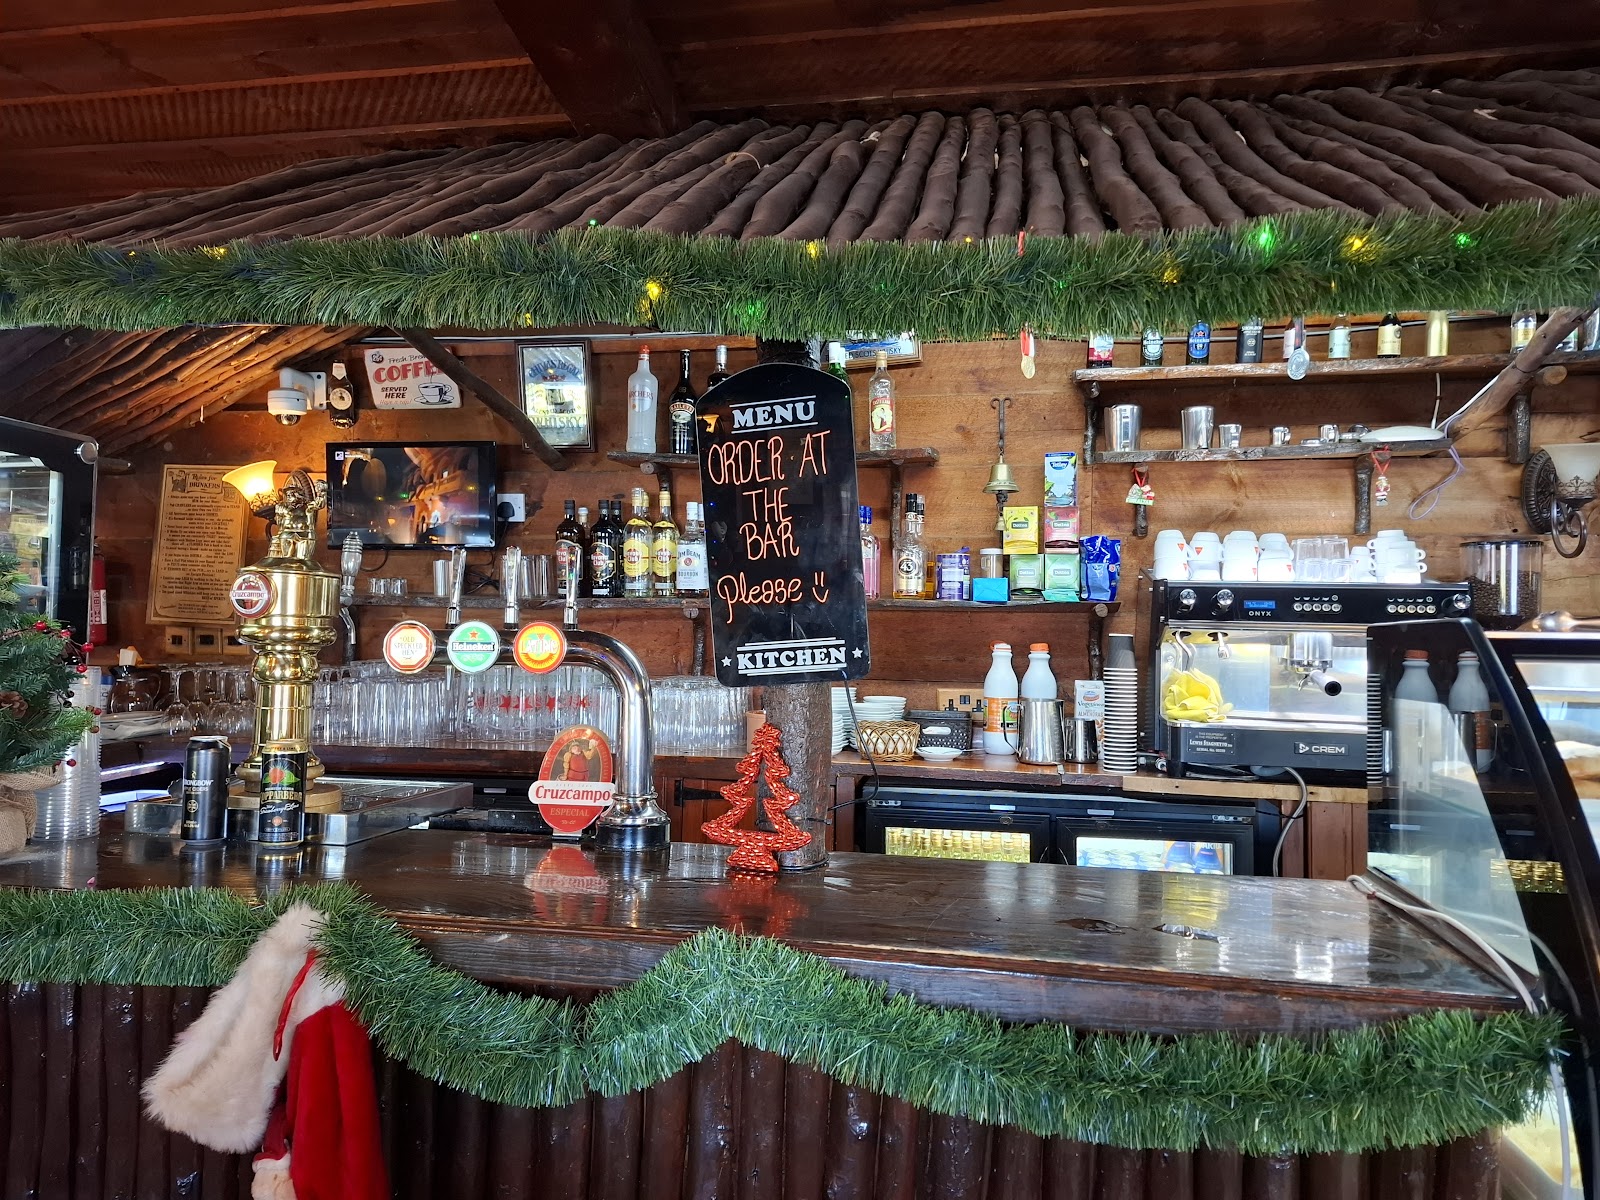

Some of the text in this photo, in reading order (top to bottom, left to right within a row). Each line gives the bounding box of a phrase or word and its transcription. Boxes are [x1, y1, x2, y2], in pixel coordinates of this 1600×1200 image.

[388, 355, 408, 364] Fresh
[373, 360, 444, 384] COFFE
[731, 400, 816, 429] MENU
[707, 430, 831, 486] ORDER AT
[742, 487, 793, 522] THE
[739, 522, 800, 561] BAR
[900, 562, 913, 571] 43
[452, 642, 495, 651] Heineken
[736, 646, 847, 671] KITCHEN
[1312, 745, 1345, 755] CREM
[535, 785, 611, 803] Cruzcampo
[550, 807, 590, 817] ESPECIAL
